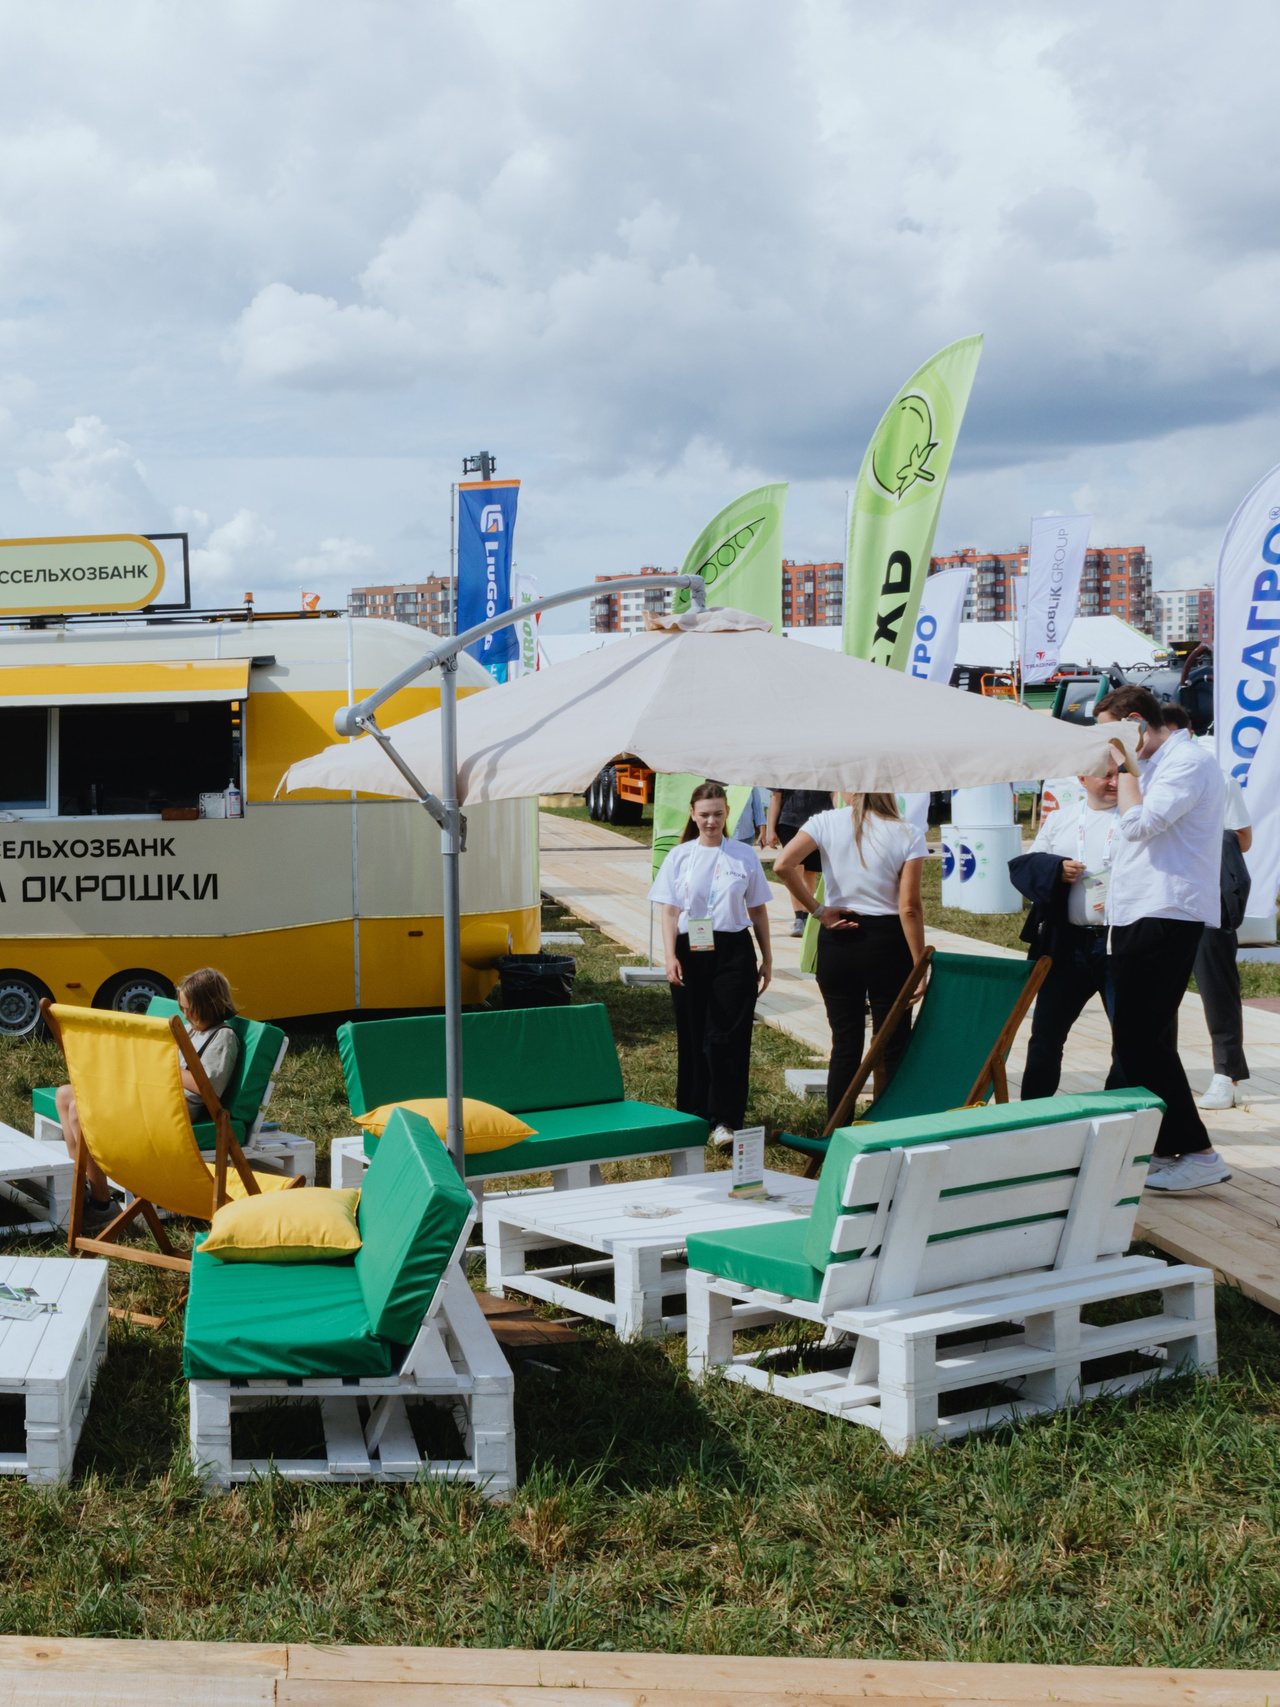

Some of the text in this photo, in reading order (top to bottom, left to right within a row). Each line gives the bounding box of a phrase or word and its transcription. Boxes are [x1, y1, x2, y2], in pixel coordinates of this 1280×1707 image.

[1051, 529, 1069, 583] GROUP
[521, 592, 535, 669] KROE
[871, 550, 912, 666] XD
[22, 873, 219, 903] ОКРОШКИ
